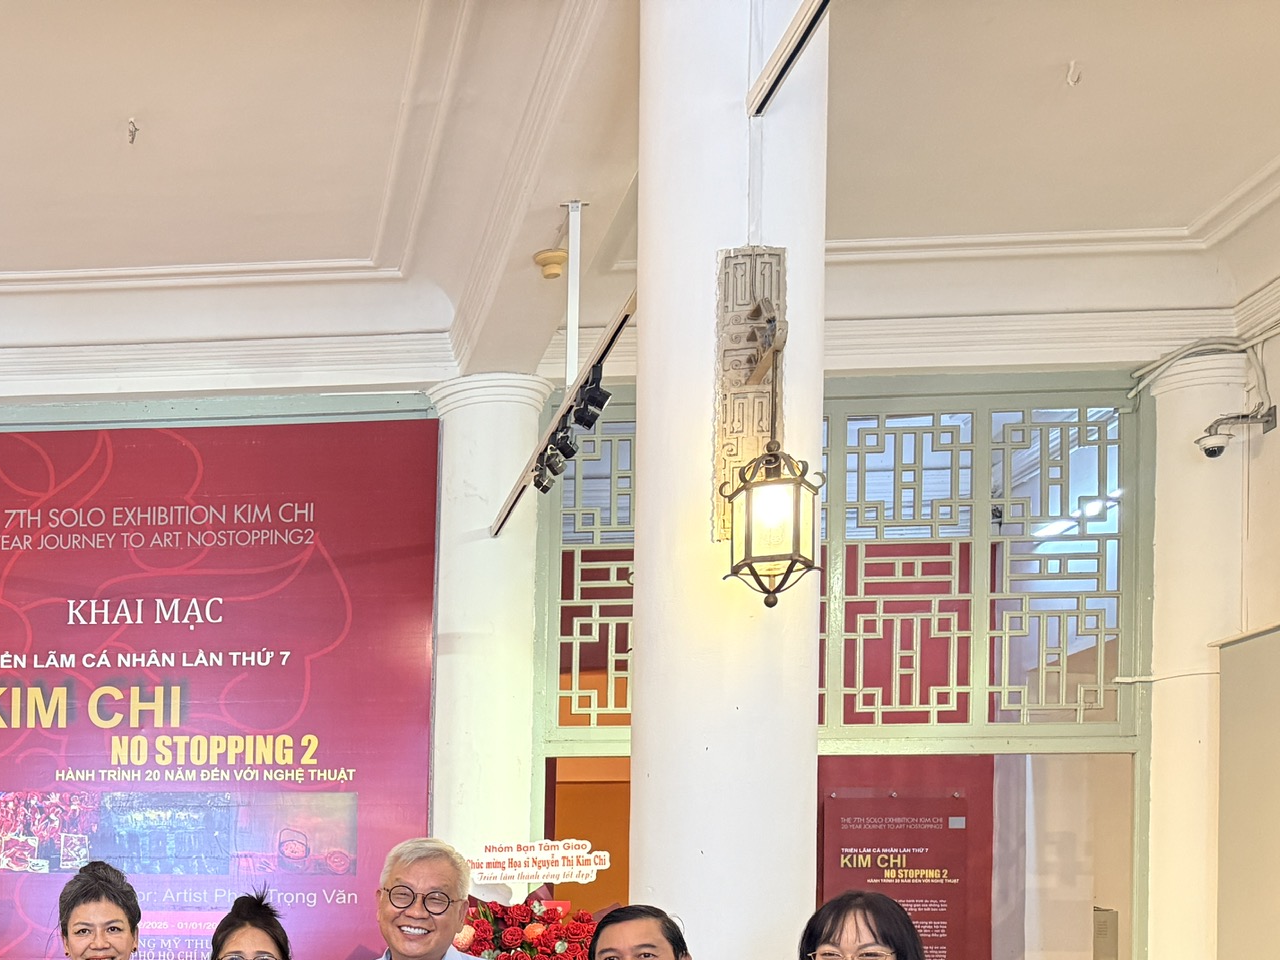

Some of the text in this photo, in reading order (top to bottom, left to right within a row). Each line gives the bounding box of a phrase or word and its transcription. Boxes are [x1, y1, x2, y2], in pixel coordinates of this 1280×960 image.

[4, 508, 41, 529] 7TH
[48, 507, 106, 528] SOLO
[112, 504, 226, 527] EXHIBITION
[234, 503, 272, 524] KIM
[278, 502, 314, 523] CHI
[37, 533, 116, 550] JOURNEY
[120, 532, 145, 548] TO
[149, 531, 182, 548] ART
[187, 528, 315, 547] NOSTOPPING2
[66, 597, 224, 630] KHAI MẠC
[33, 650, 76, 668] LÃM
[81, 649, 111, 668] CÁ
[117, 649, 175, 668] NHÂN
[182, 649, 223, 667] LẦN
[228, 649, 275, 667] THỨ
[279, 651, 291, 666] 7
[87, 685, 181, 729] CHI
[110, 734, 319, 766] NO STOPPING 2
[55, 766, 356, 784] HÀNH TRÌNH 20 NĂM ĐẾN VỚI NGHỆ THUẬT
[516, 844, 535, 854] Bạn
[562, 842, 588, 850] Giao
[561, 855, 573, 869] Thị
[576, 855, 591, 866] Kim
[593, 854, 606, 866] Chi
[840, 853, 907, 868] KIM CHI
[884, 869, 948, 879] NO STOPPING 2
[162, 888, 208, 903] Artist
[267, 889, 317, 907] Trọng
[322, 889, 358, 904] Văn
[177, 921, 218, 930] 01/01/20
[138, 937, 211, 949] NG MỸ THU
[177, 949, 197, 960] CHÍ
